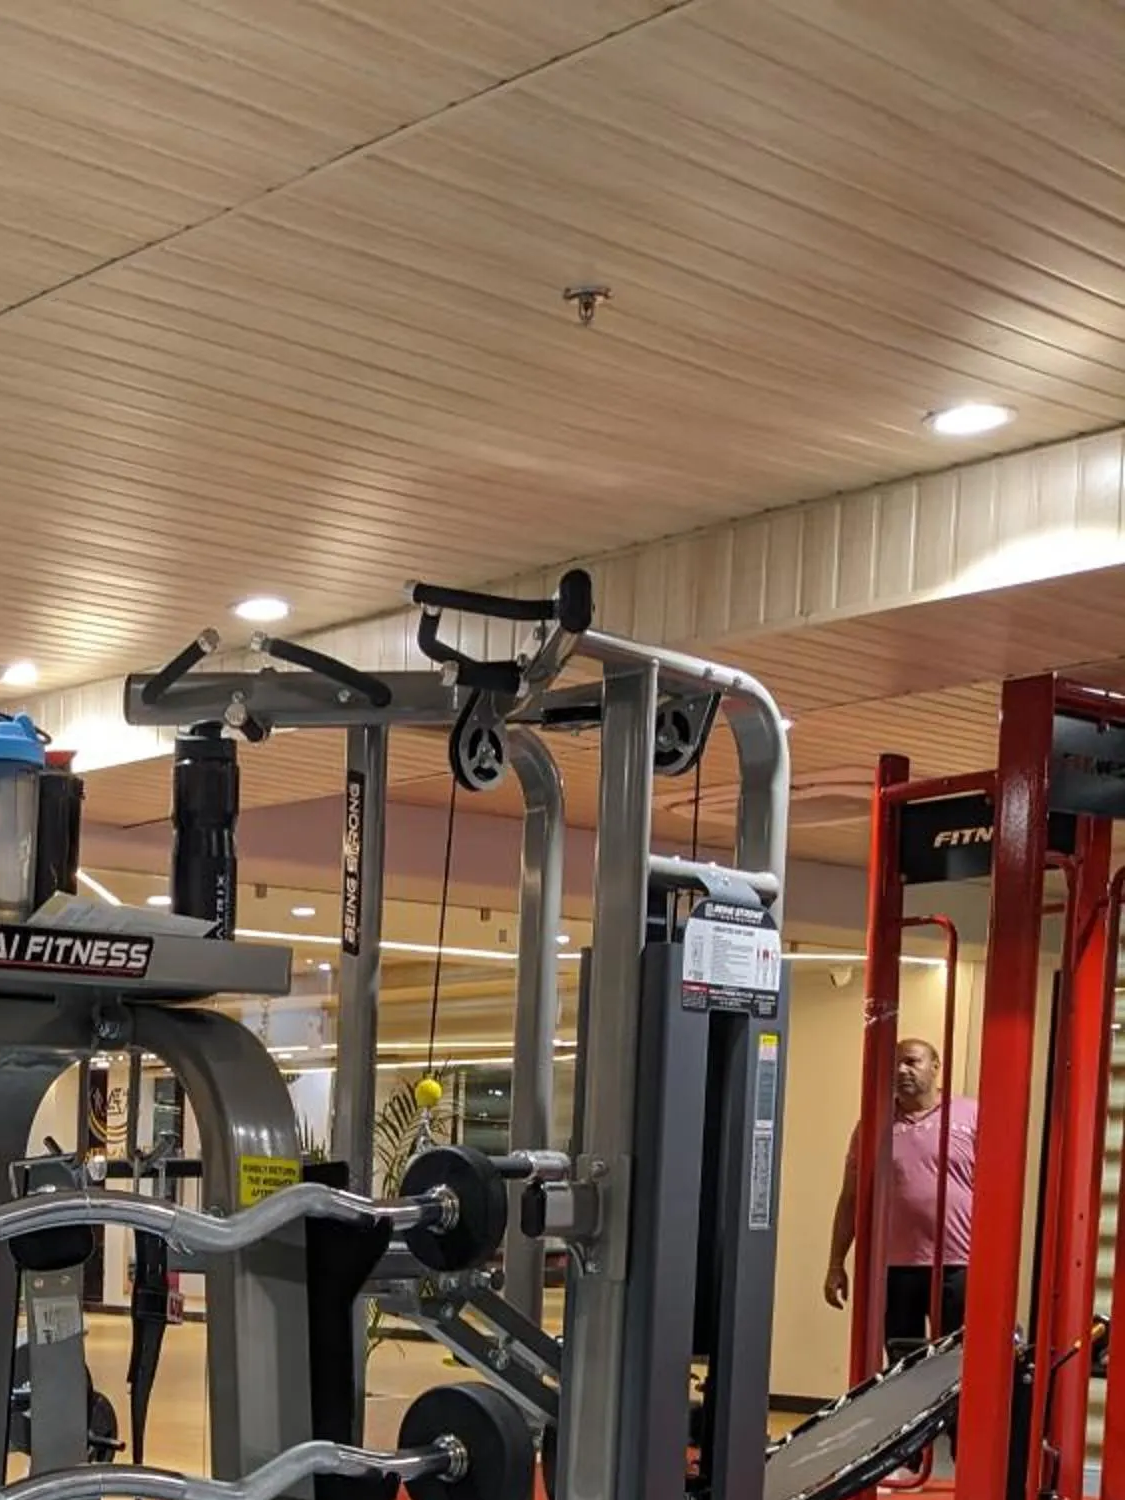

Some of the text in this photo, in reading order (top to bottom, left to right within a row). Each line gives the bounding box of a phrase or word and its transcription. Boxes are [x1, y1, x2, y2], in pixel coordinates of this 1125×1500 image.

[933, 826, 994, 849] FITN
[344, 877, 359, 943] BEING
[25, 935, 150, 969] FITNESS
